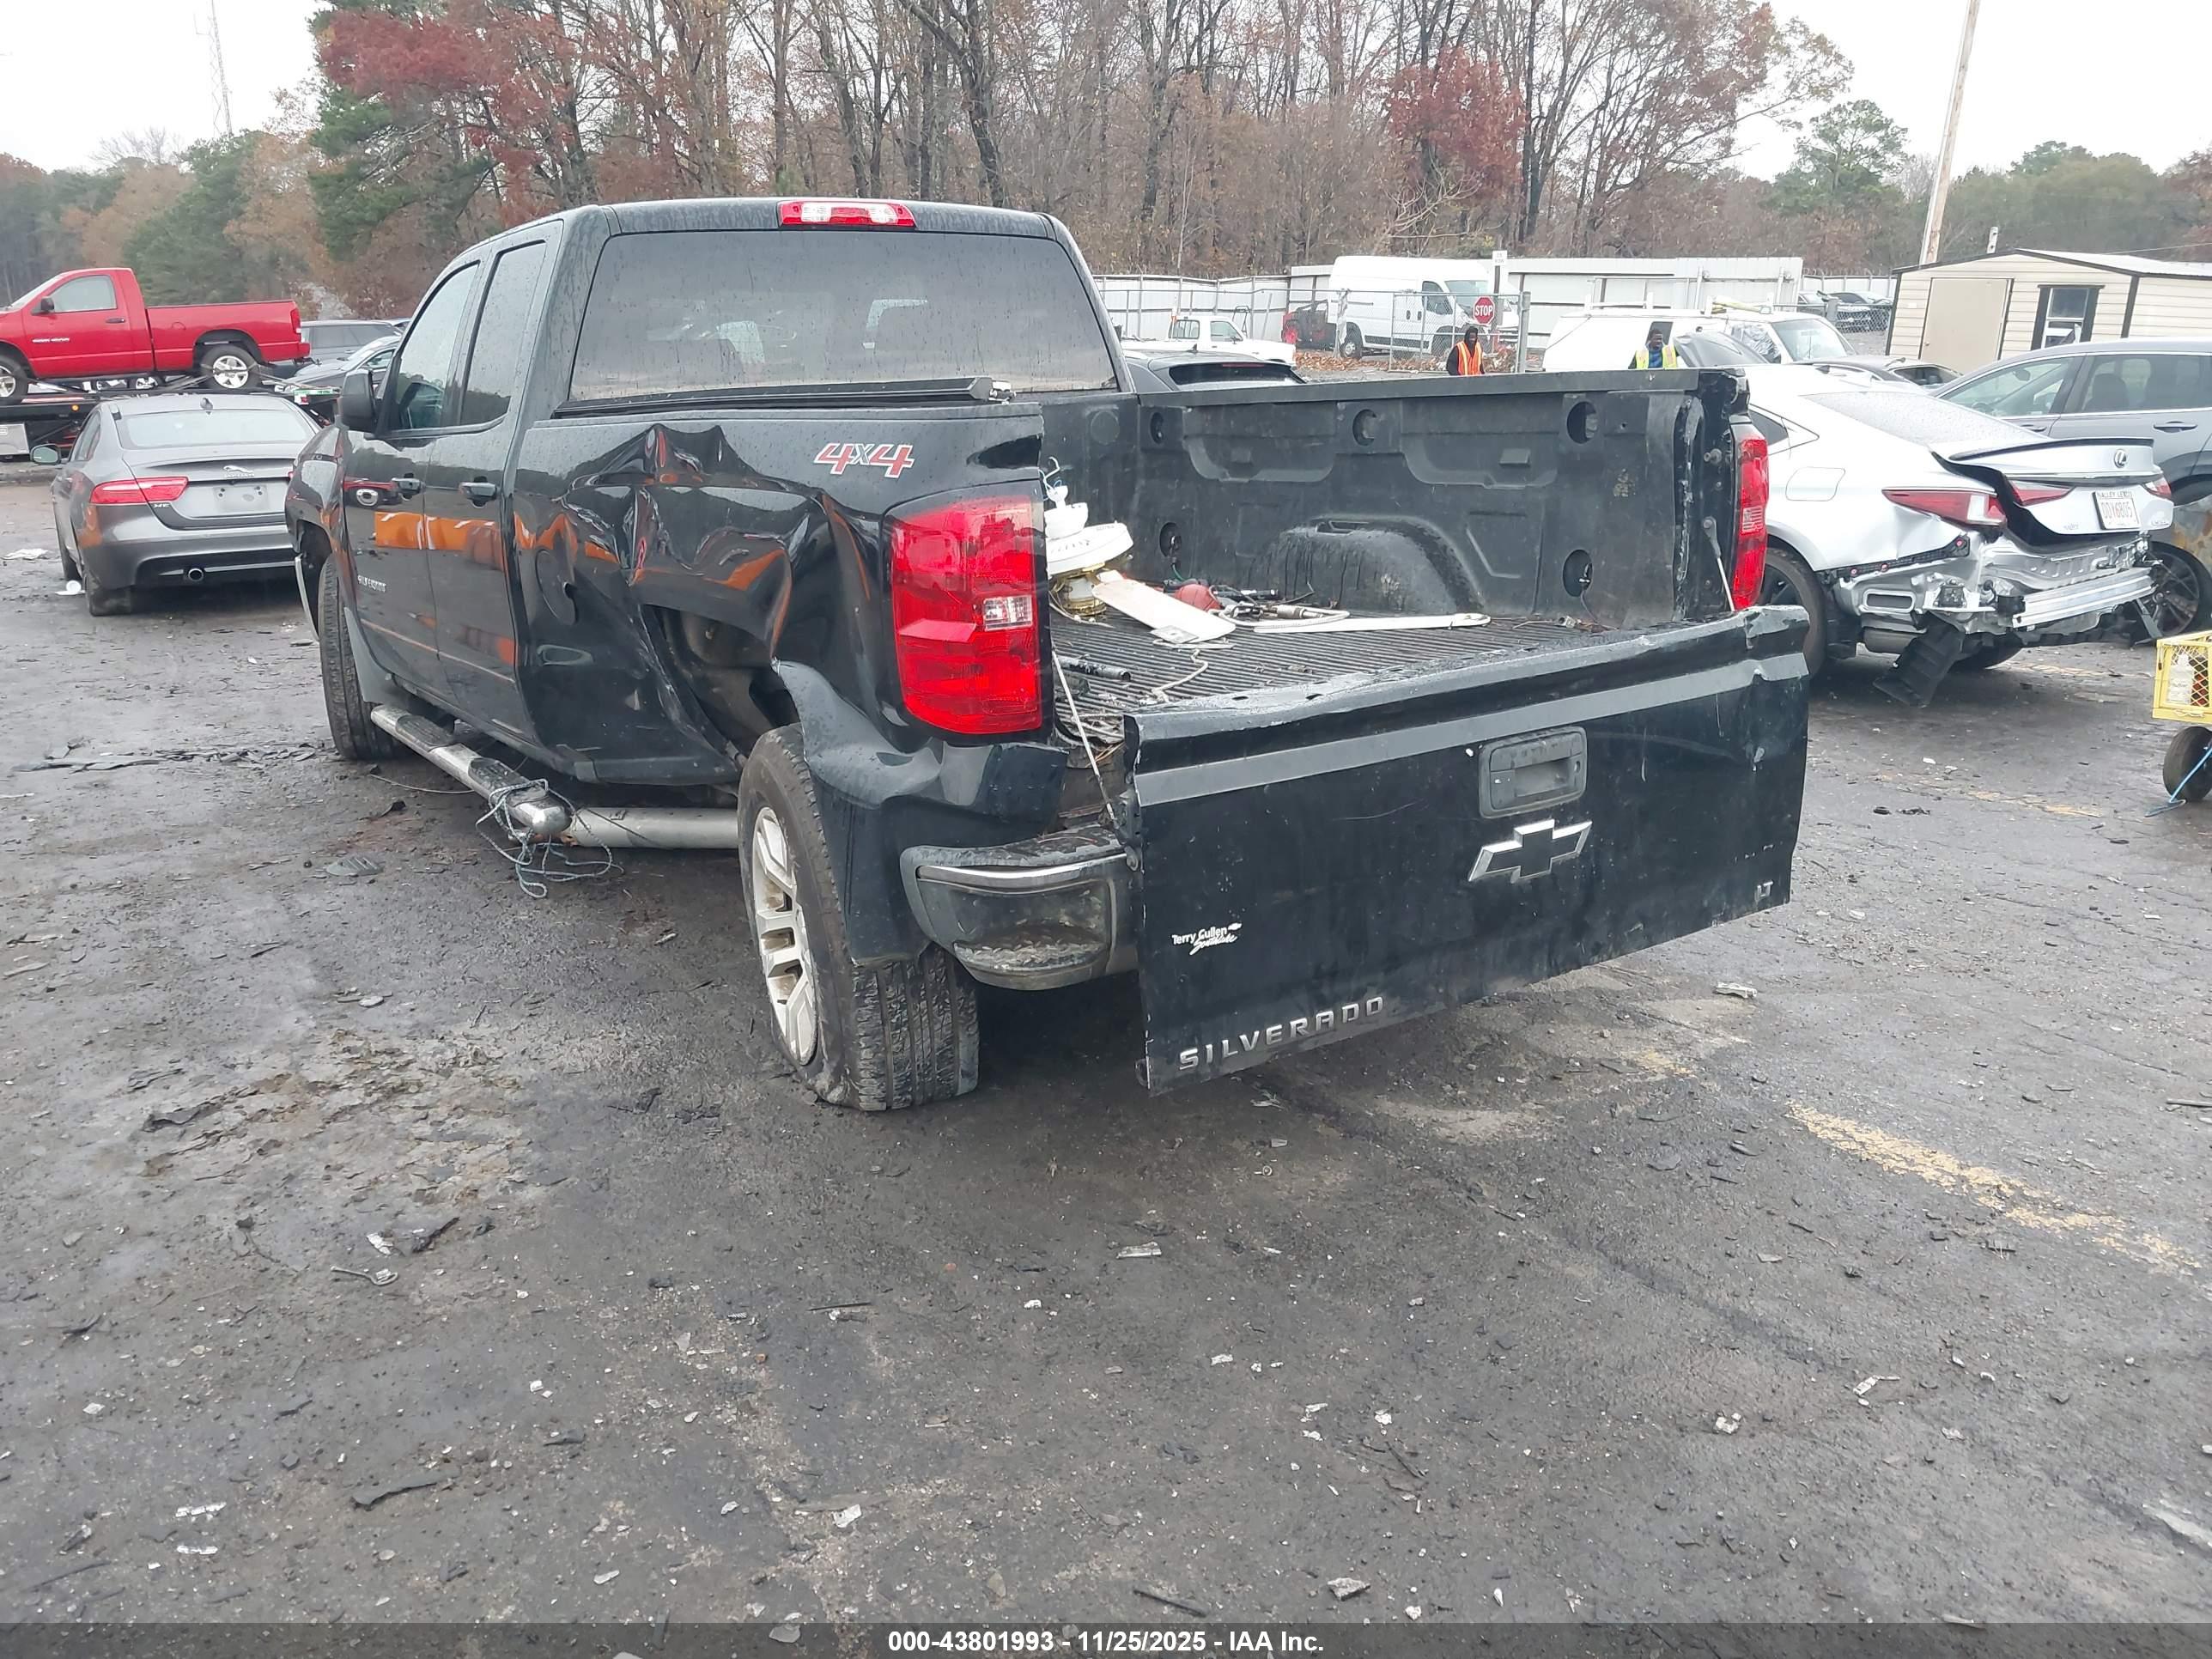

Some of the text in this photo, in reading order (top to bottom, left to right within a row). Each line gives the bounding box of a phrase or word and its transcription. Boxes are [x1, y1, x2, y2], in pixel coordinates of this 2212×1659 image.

[1474, 305, 1493, 317] STOP
[1171, 927, 1228, 945] Terry Cullen
[1179, 996, 1383, 1071] SILVERADO
